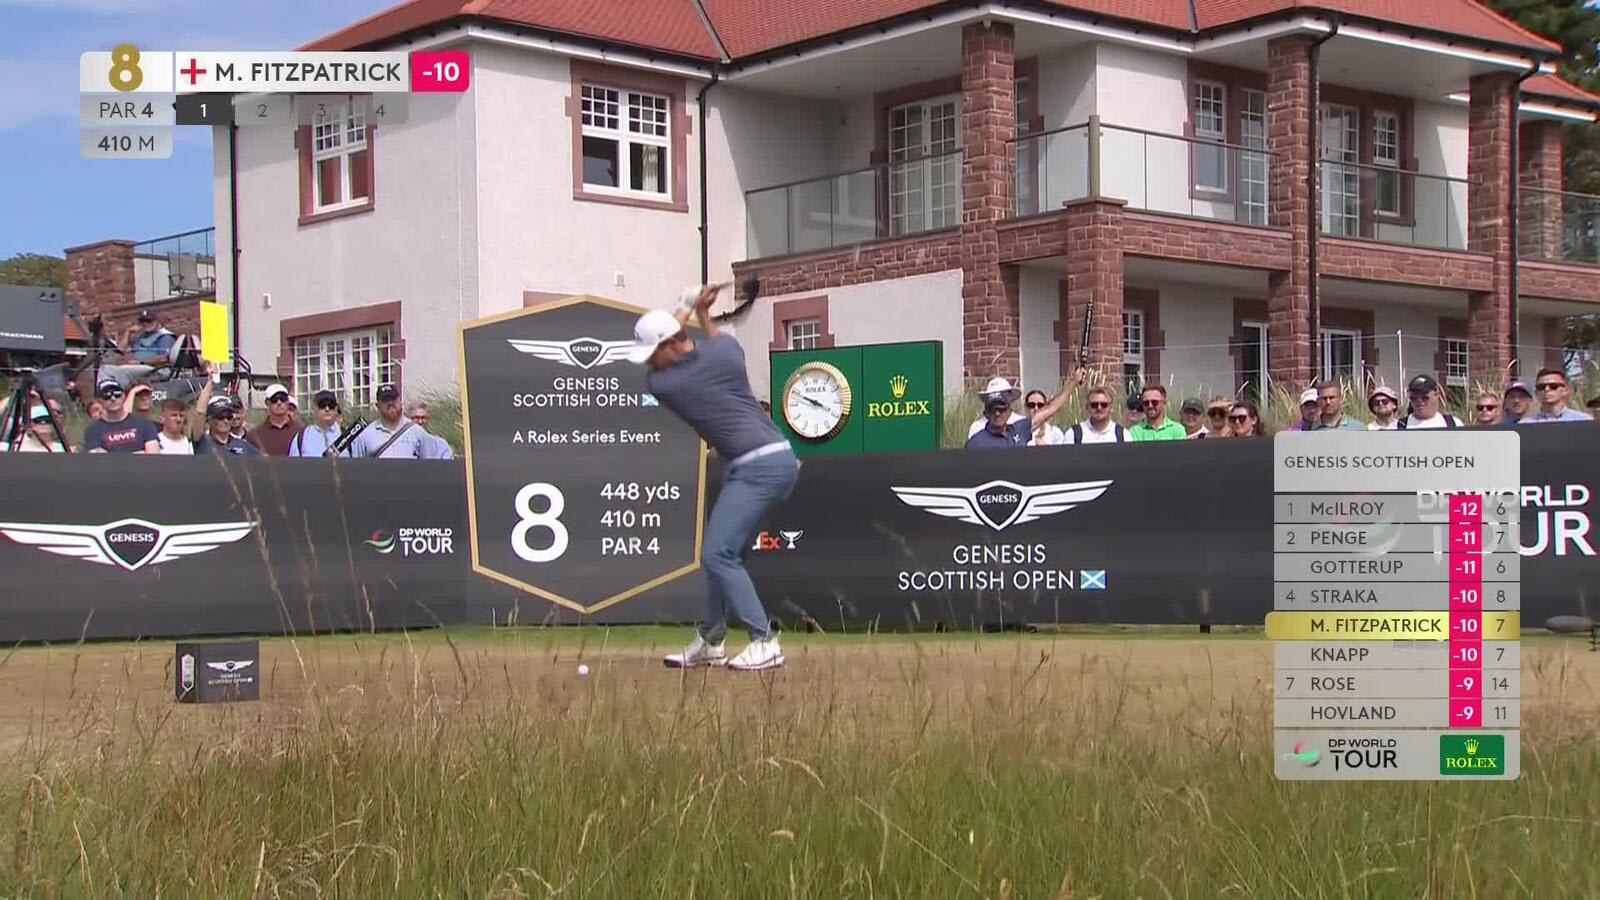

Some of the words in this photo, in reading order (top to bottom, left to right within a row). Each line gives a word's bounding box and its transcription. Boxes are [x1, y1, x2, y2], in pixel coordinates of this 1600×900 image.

[572, 345, 600, 353] GENESIS
[553, 377, 620, 391] GENESIS
[513, 393, 591, 407] SCOTTISH
[596, 393, 638, 407] OPEN
[868, 400, 930, 418] ROLEX
[513, 431, 523, 444] A
[528, 430, 568, 444] Rolex
[573, 430, 615, 444] Series
[620, 431, 661, 444] Event
[601, 483, 640, 500] 448
[645, 481, 681, 504] yds
[980, 494, 1017, 504] GENESIS
[510, 481, 569, 563] 8
[600, 511, 635, 528] 410
[642, 514, 661, 528] m
[109, 532, 155, 542] GENESIS
[400, 528, 413, 537] DP
[414, 528, 453, 537] WORLD
[400, 537, 454, 557] TOUR
[602, 538, 642, 555] PAR
[647, 538, 660, 555] 4
[953, 544, 1046, 564] GENESIS
[898, 570, 1004, 590] SCOTTISH
[1013, 570, 1074, 590] OPEN
